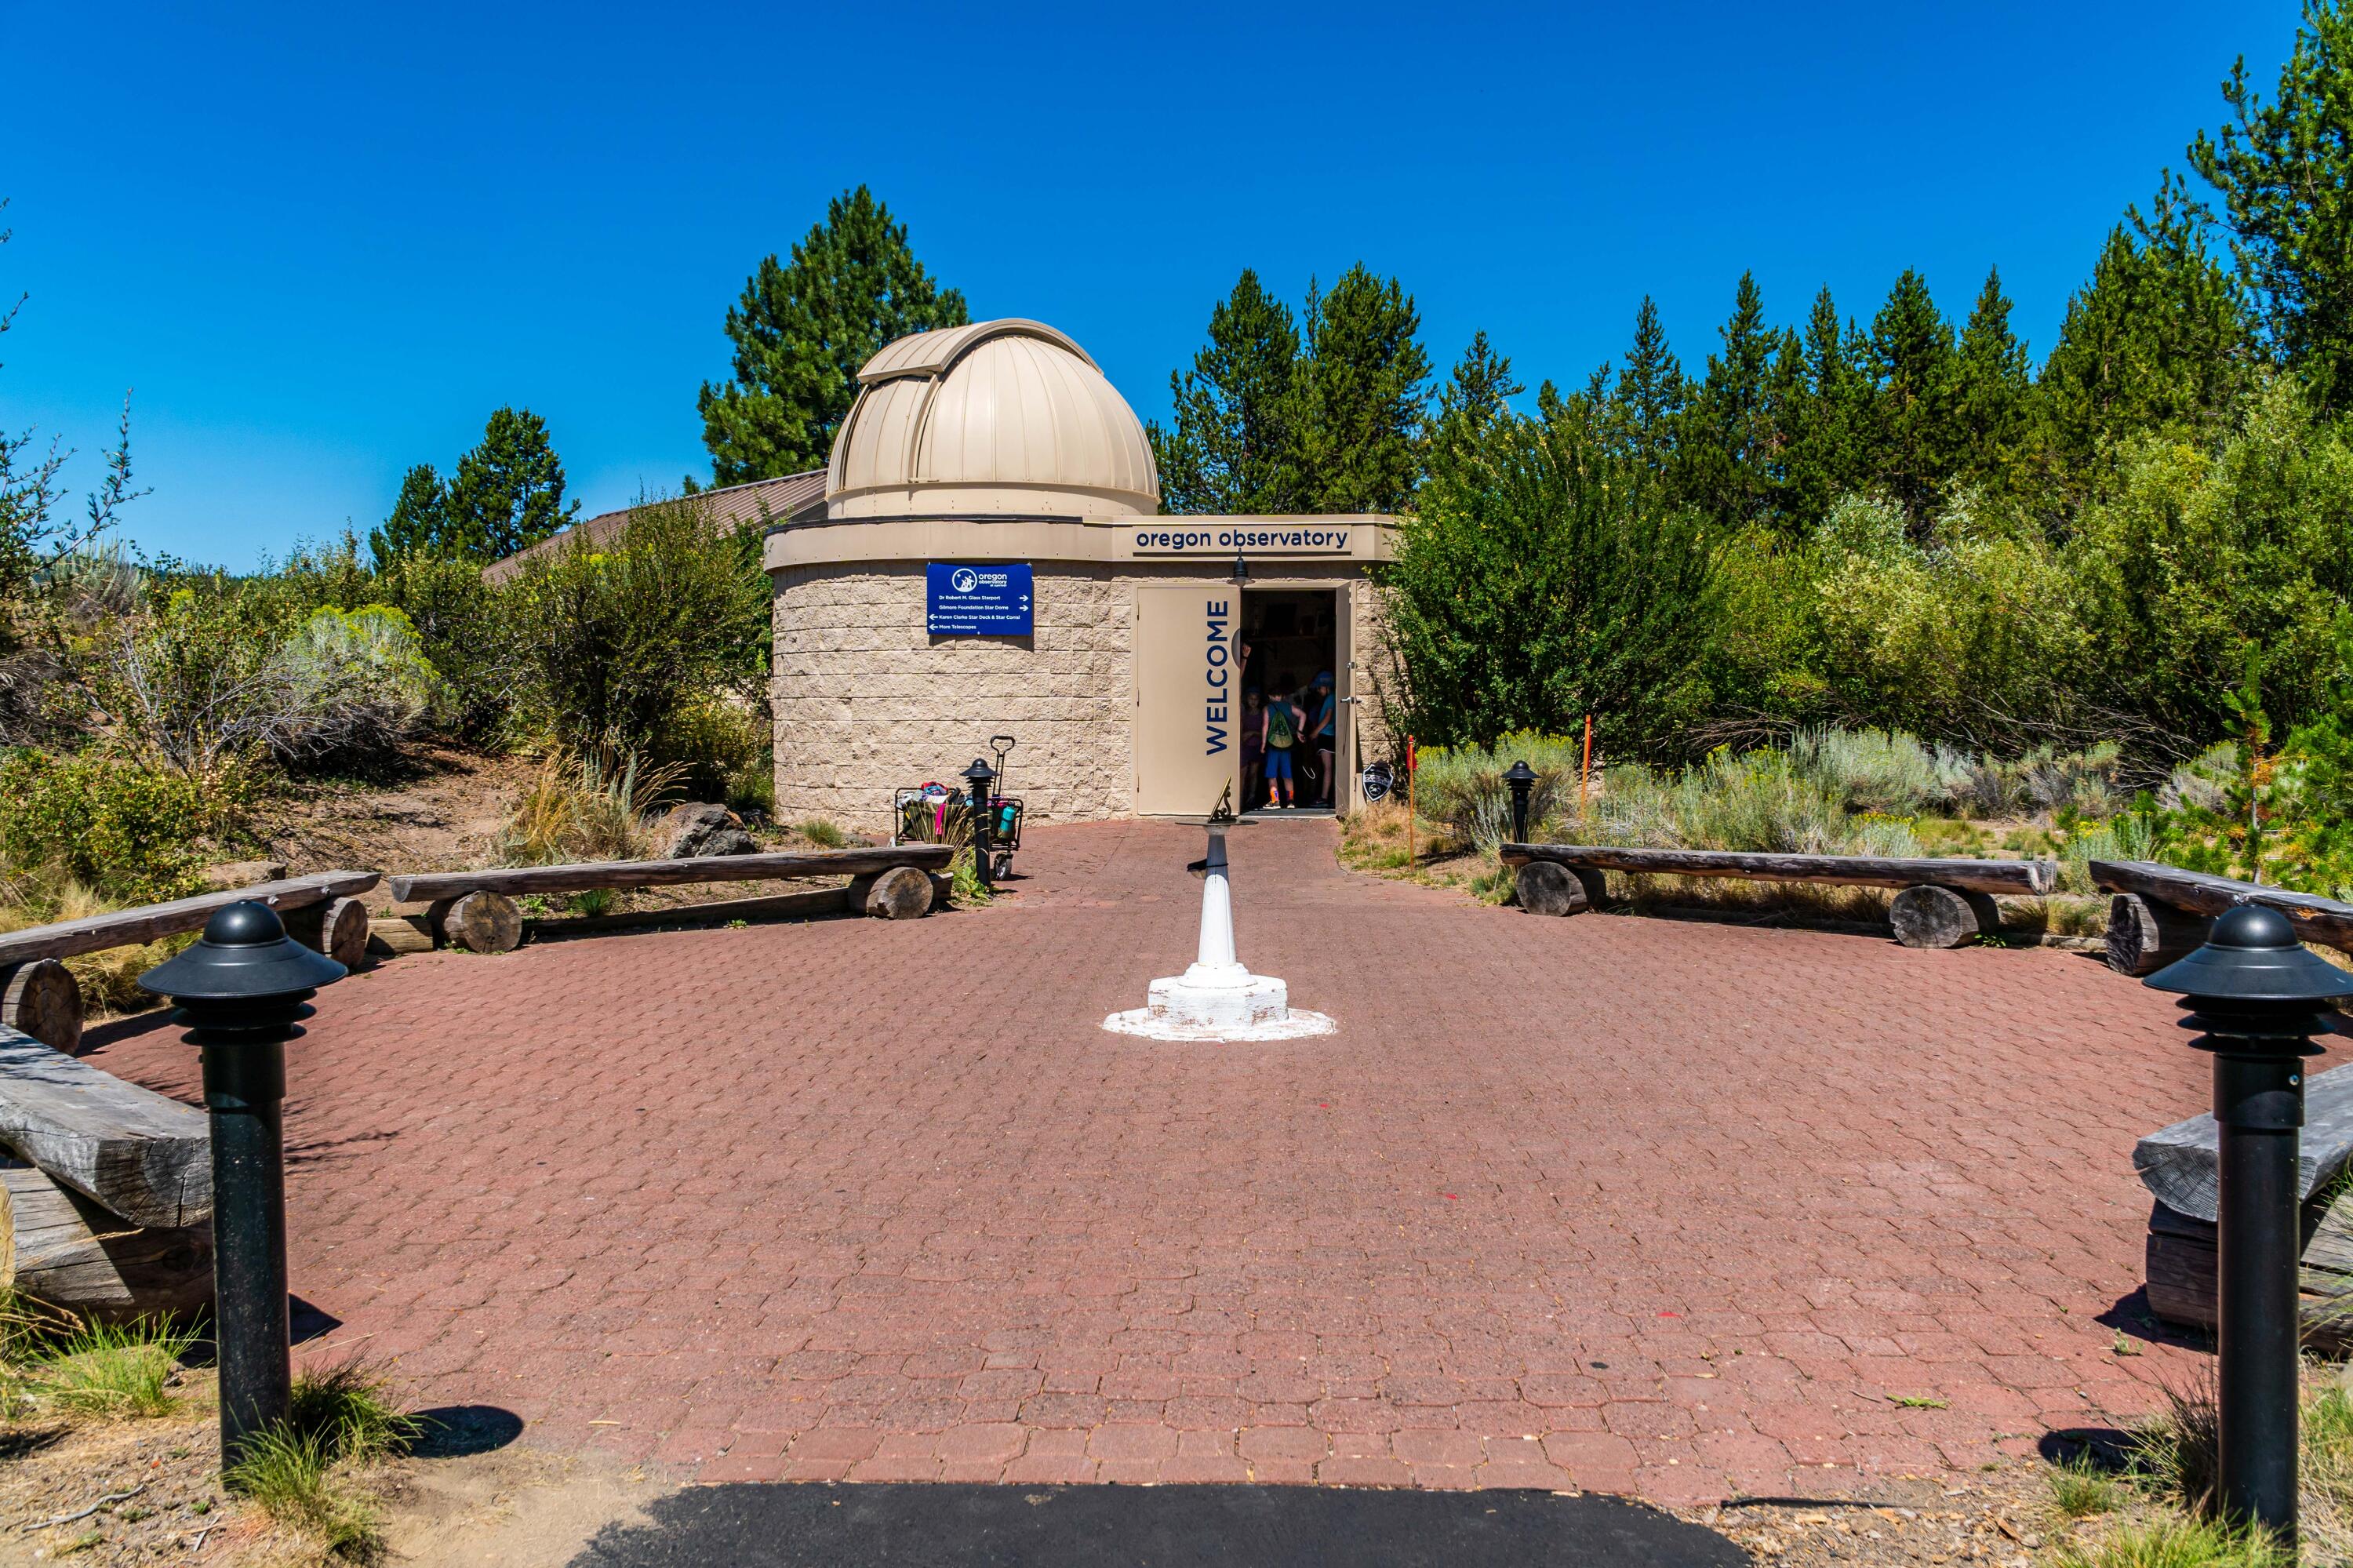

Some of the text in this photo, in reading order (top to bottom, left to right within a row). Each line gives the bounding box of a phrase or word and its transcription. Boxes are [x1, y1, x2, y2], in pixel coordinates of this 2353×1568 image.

[1136, 529, 1348, 550] oregon observatory
[1206, 600, 1228, 756] WELCOME
